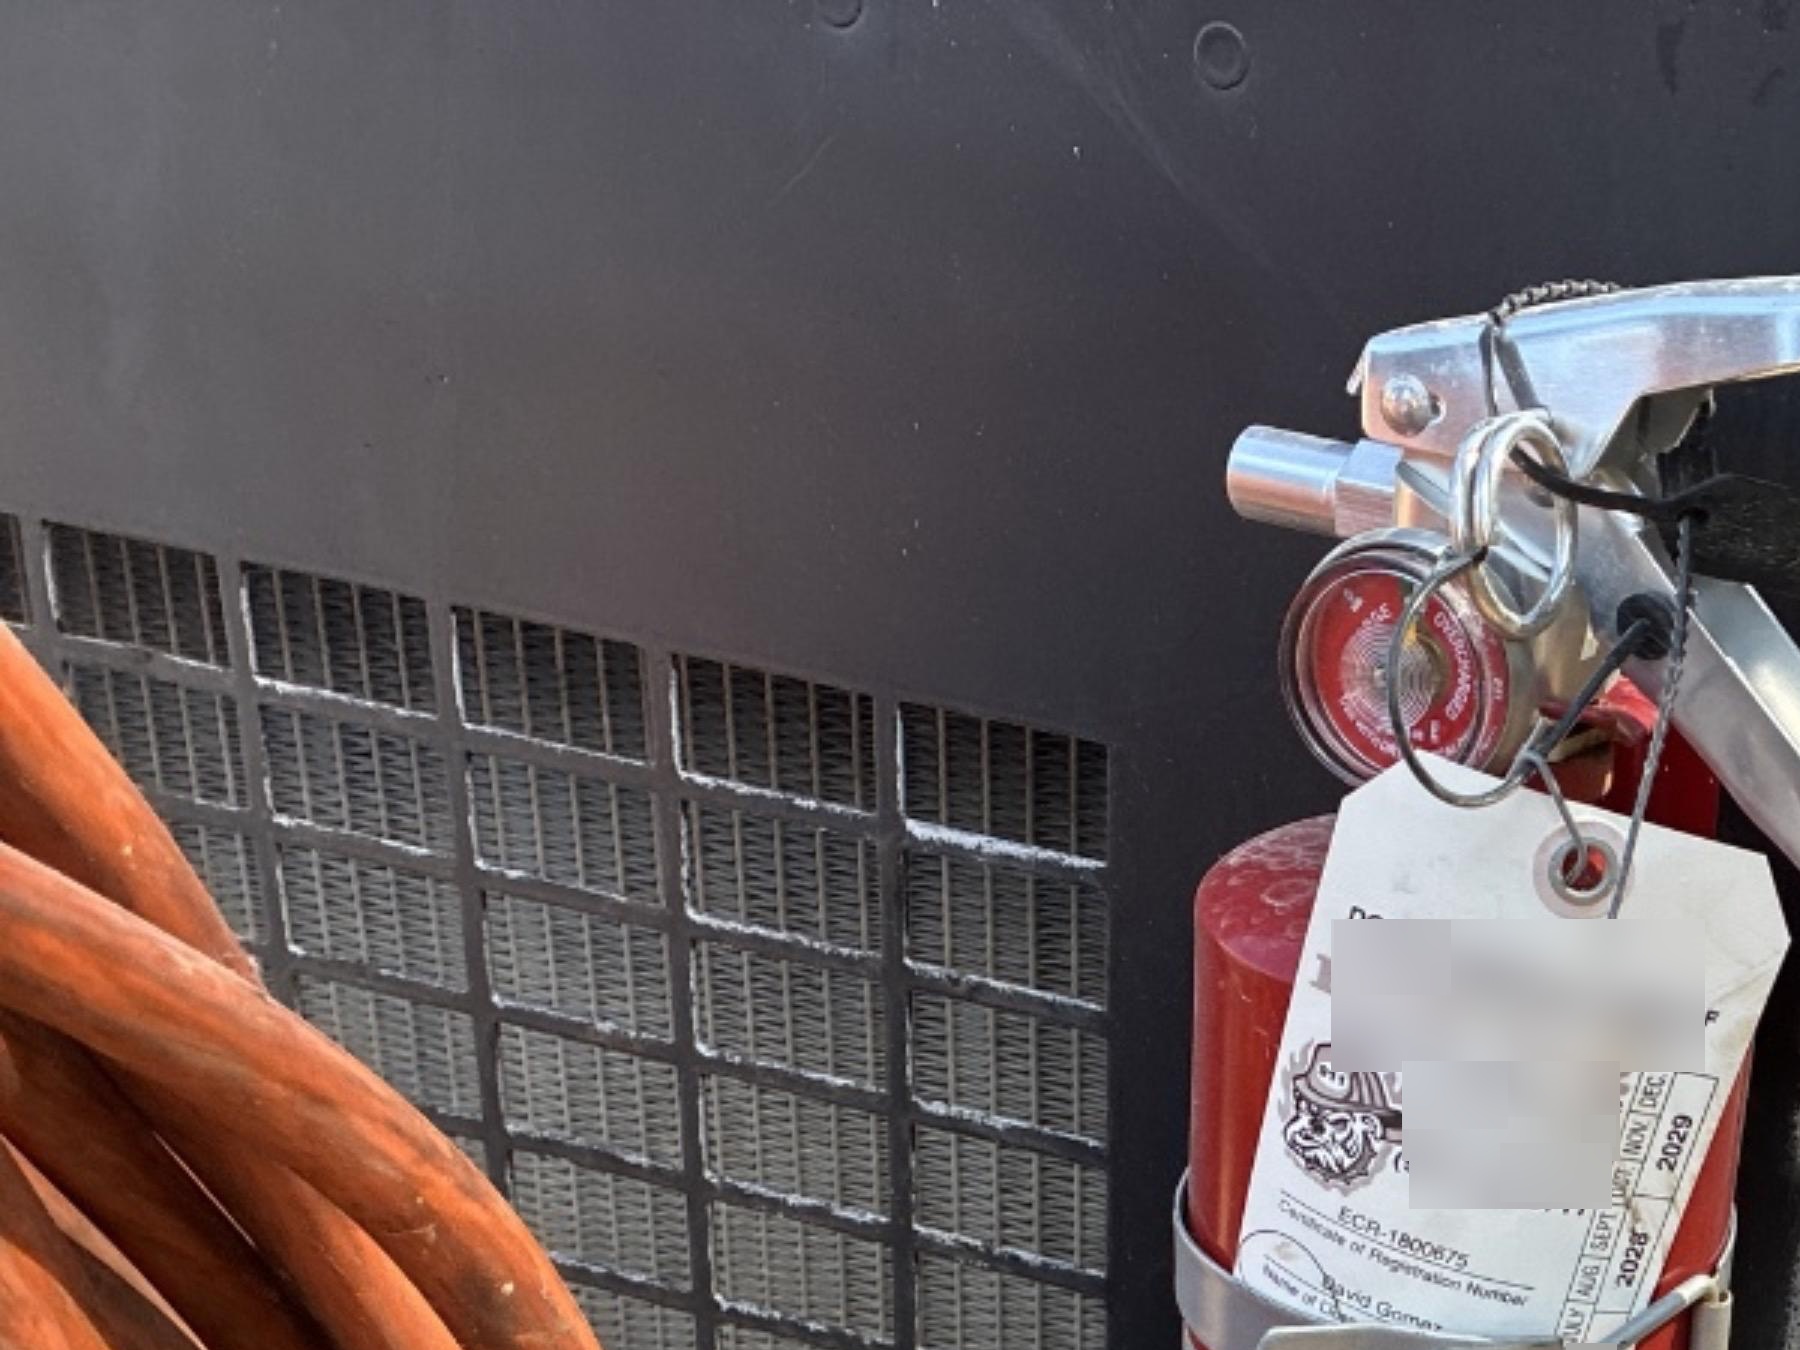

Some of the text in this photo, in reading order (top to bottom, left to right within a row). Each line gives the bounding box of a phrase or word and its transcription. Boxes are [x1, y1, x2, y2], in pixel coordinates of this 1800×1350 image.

[1639, 1073, 1669, 1110] DEC.
[1622, 1120, 1650, 1156] NOV
[1656, 1113, 1694, 1174] 2029
[1590, 1209, 1617, 1252] SEPT
[1277, 1198, 1529, 1308] Certificate of Registration Number
[1615, 1231, 1651, 1290] 2028
[1576, 1263, 1600, 1298] AUG
